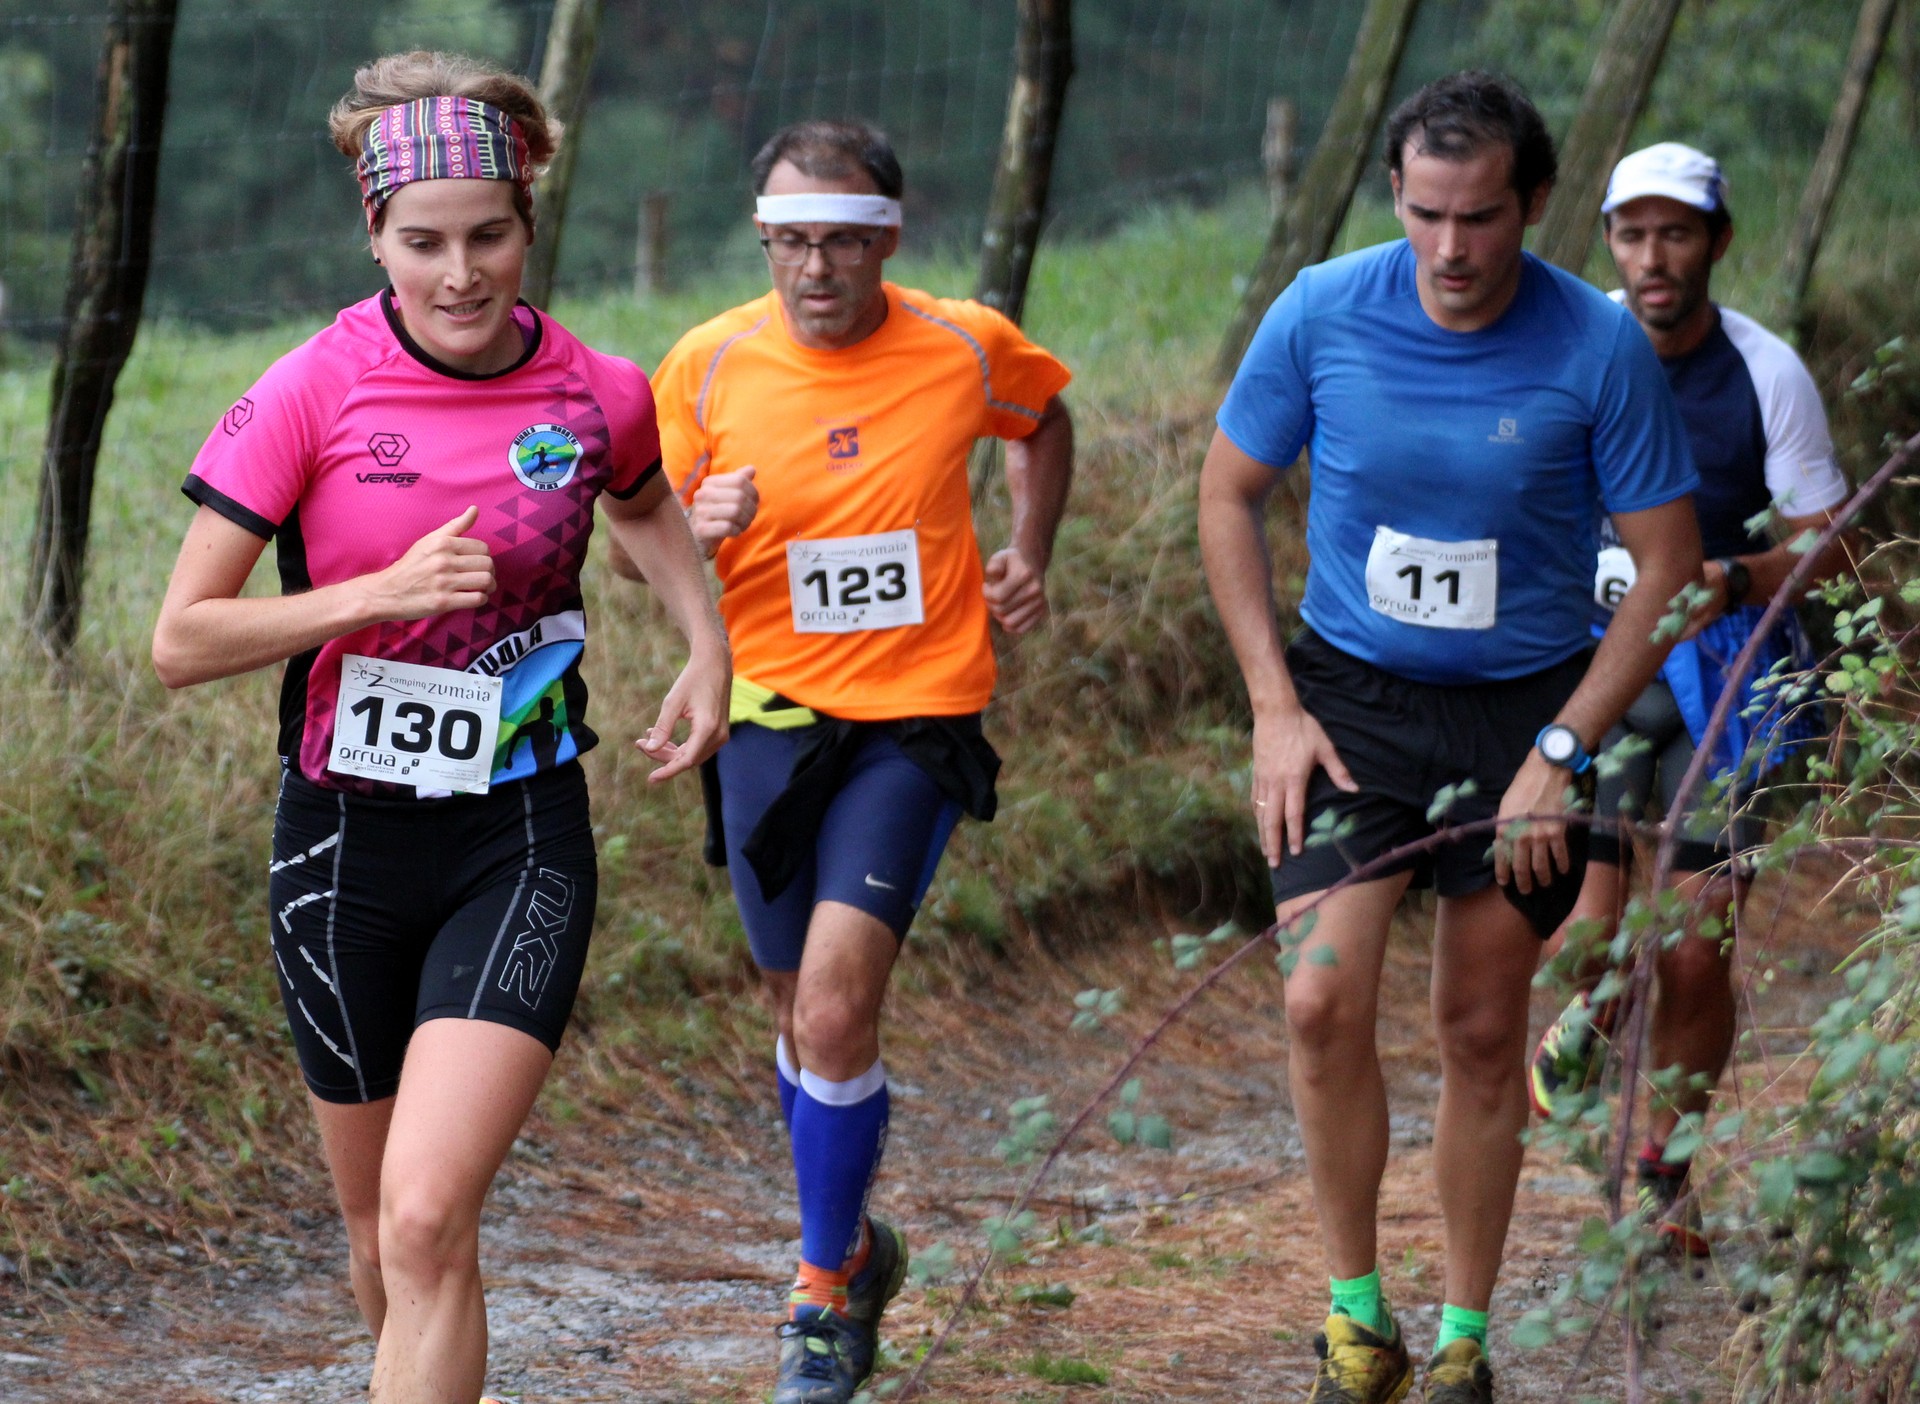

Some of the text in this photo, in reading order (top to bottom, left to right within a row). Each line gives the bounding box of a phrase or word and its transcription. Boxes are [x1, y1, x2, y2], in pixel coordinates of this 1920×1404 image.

[355, 472, 422, 483] VERGE
[857, 541, 908, 557] zumaia
[801, 561, 907, 608] 123
[1396, 564, 1460, 605] 11
[1373, 594, 1418, 613] orrua
[800, 610, 848, 622] orrua
[428, 682, 491, 702] zumaia
[350, 695, 482, 760] 130
[339, 747, 396, 767] orrua
[498, 867, 576, 1011] 2XU
